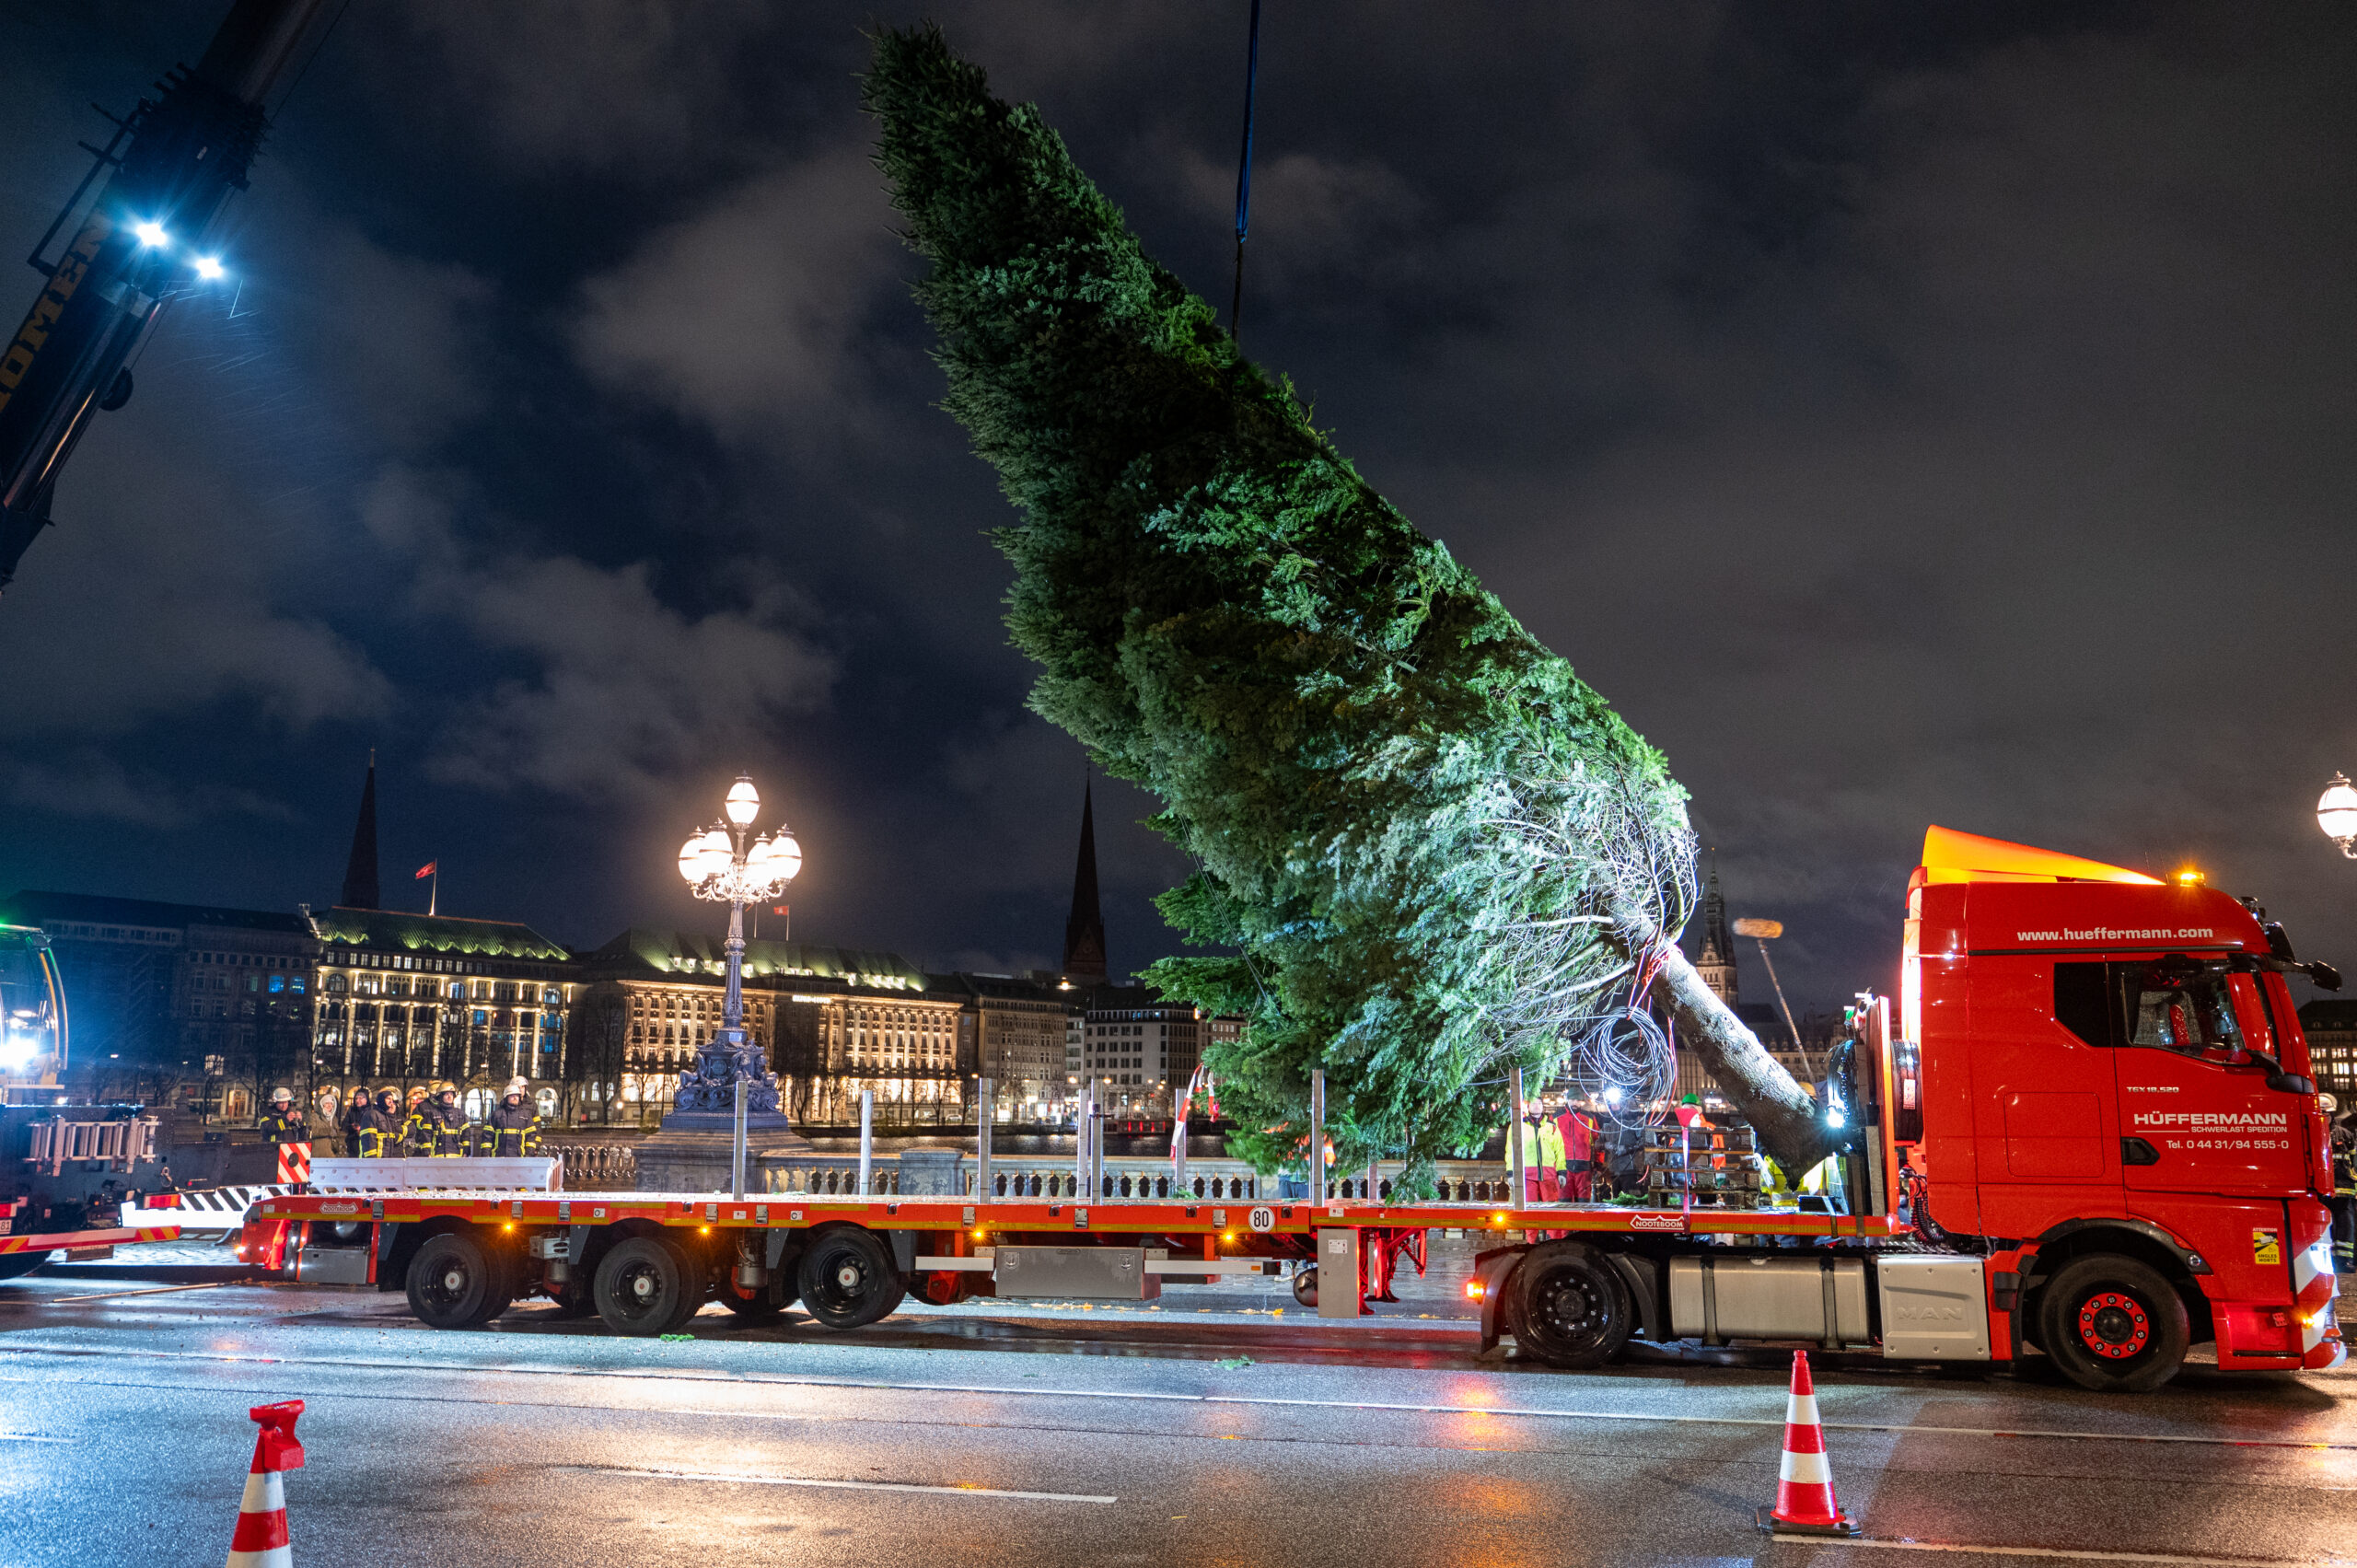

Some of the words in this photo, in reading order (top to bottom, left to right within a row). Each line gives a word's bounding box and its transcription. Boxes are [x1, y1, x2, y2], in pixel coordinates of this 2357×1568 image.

[2016, 926, 2213, 941] www.hueffermann.com
[2133, 1110, 2287, 1125] HÜFFERMANN
[2165, 1140, 2184, 1149] Tel.
[2186, 1140, 2195, 1149] 0
[2196, 1140, 2212, 1149] 44
[2214, 1139, 2251, 1150] 31/94
[2253, 1139, 2290, 1149] 555-0
[1253, 1210, 1270, 1227] 80
[1896, 1307, 1964, 1320] MAN
